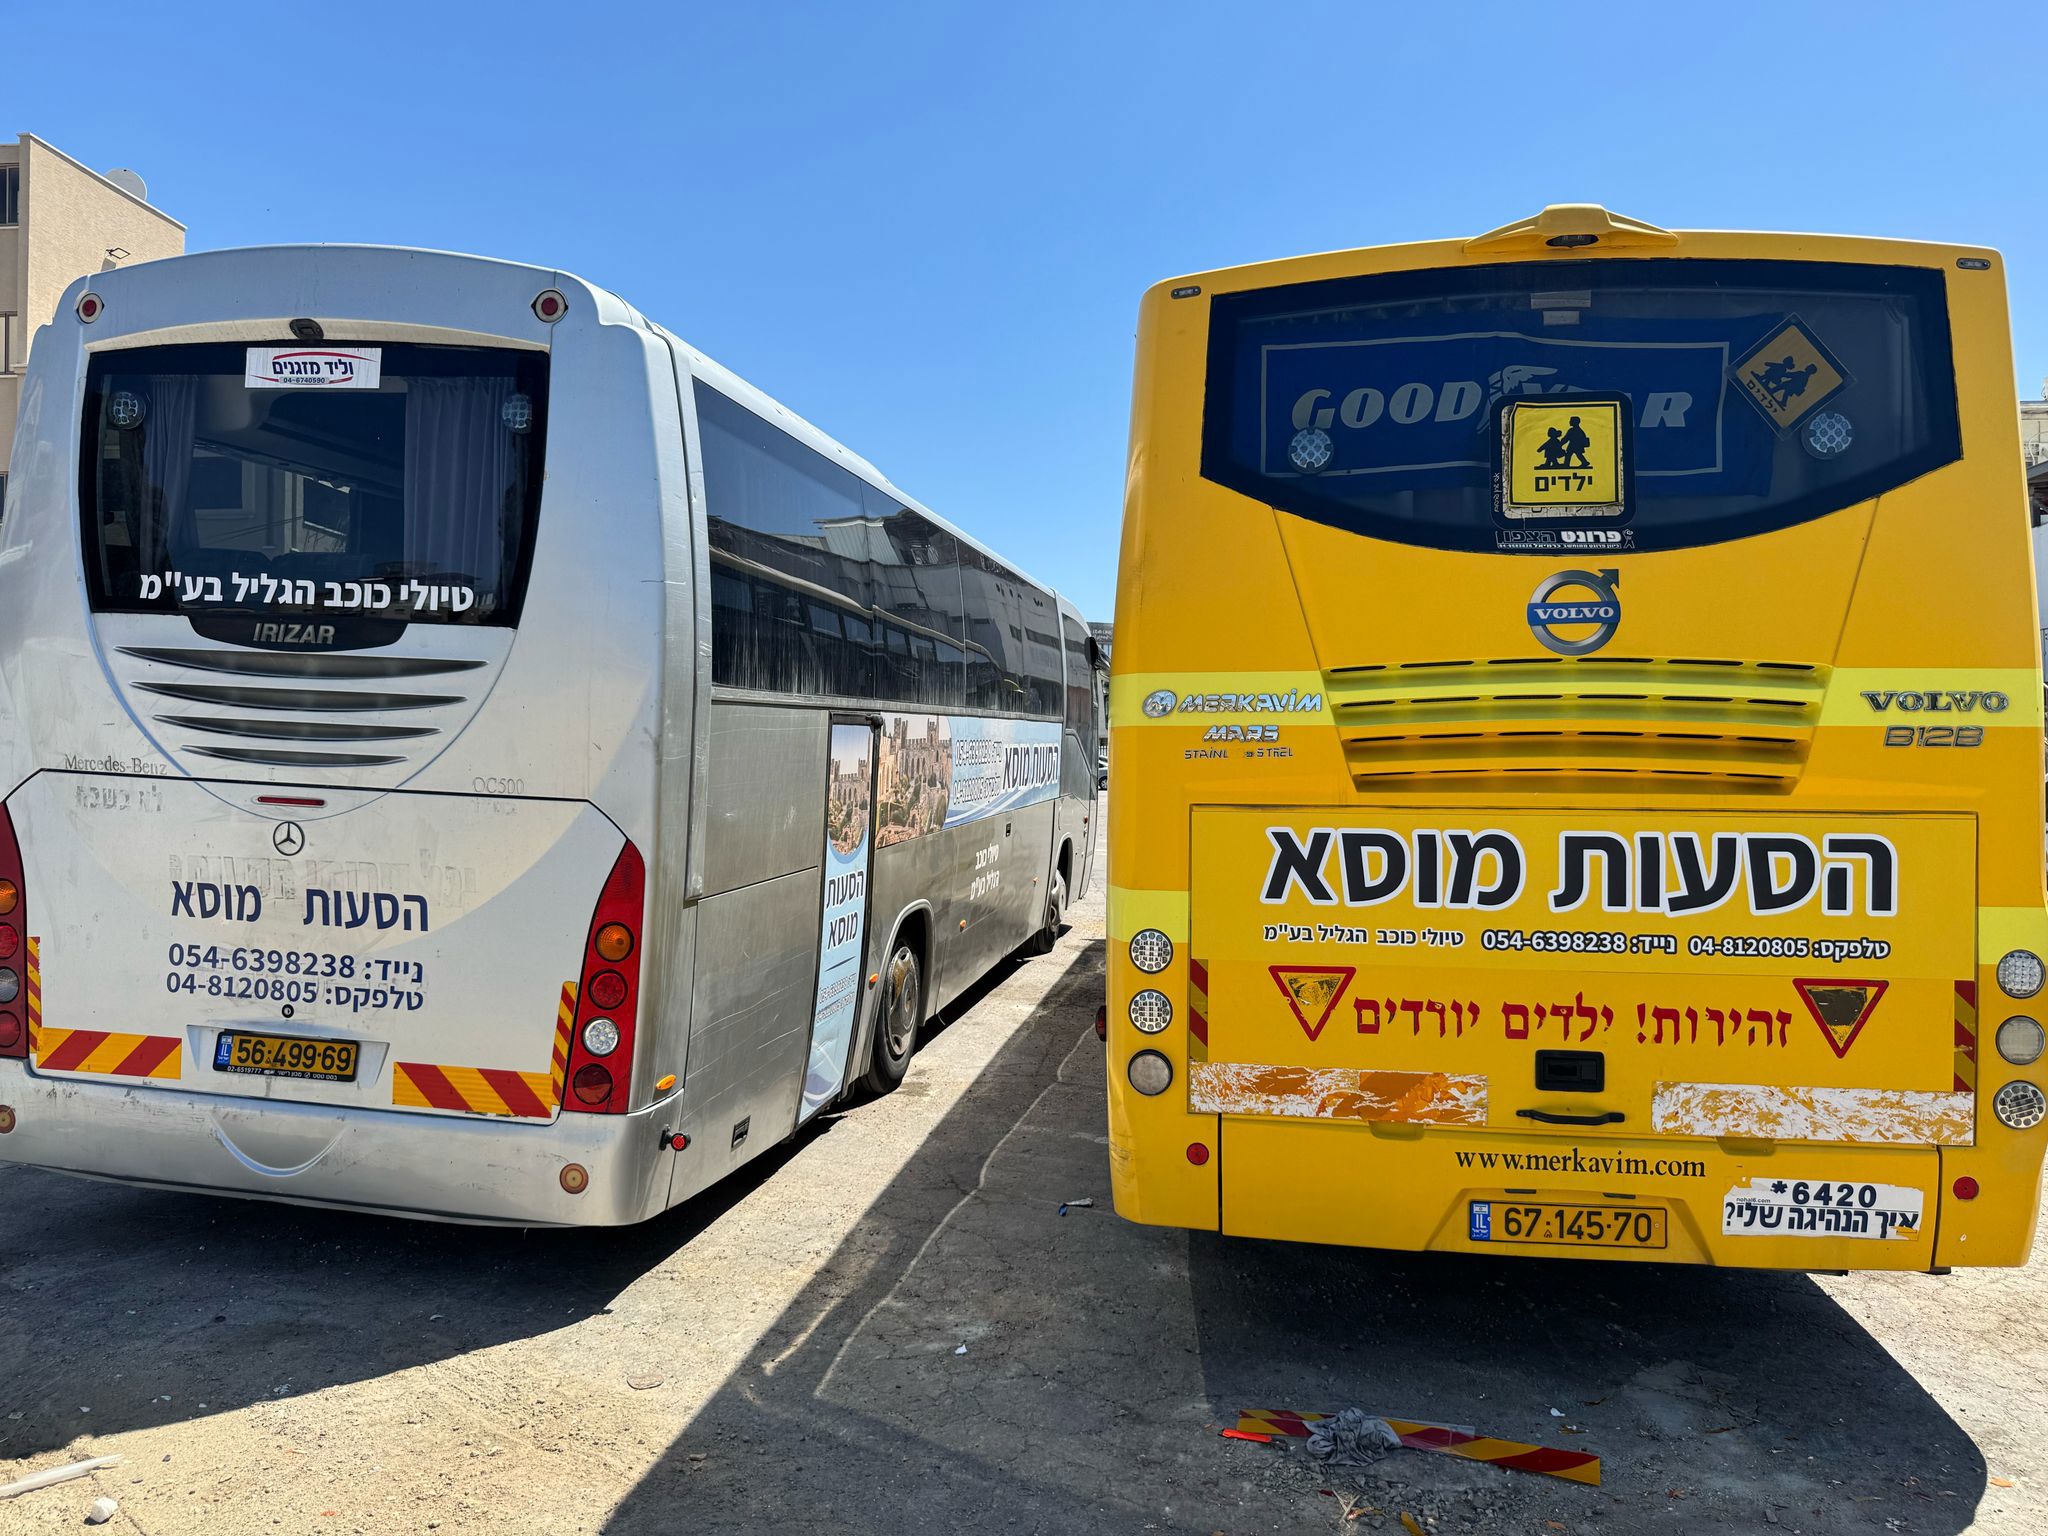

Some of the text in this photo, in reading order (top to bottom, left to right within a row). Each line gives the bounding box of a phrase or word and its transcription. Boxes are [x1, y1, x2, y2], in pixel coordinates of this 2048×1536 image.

[272, 359, 354, 375] וליד מזגנים
[1534, 472, 1594, 492] ילדים
[1560, 530, 1622, 543] פרונט
[231, 572, 315, 605] הגליל
[323, 581, 392, 609] כוכב
[400, 579, 475, 612] טיולי
[1533, 606, 1614, 619] VOLVO
[253, 622, 336, 645] IRIZAR
[1860, 691, 2009, 713] VOLVO
[1202, 724, 1280, 743] MARS
[1883, 725, 1985, 748] B12B
[64, 754, 168, 775] Mercedes-Benz
[1002, 745, 1059, 790] הסעות מוסא
[472, 777, 525, 794] OC500
[1260, 826, 1900, 918] הסעות מוסא
[826, 870, 864, 909] הסעות
[171, 880, 429, 931] הסעות מוסא
[827, 911, 859, 950] מוסא
[1317, 924, 1369, 944] הגליל
[1376, 930, 1417, 946] כוכב
[1421, 928, 1465, 947] טיולי
[1481, 929, 1892, 963] טלפקס: 04-8120805 נייד: 054-6398238
[168, 943, 424, 983] נייד: 054-6398238
[166, 972, 424, 1012] טלפקס: 04-8120805
[1353, 991, 1793, 1048] זהירות! ילדים יורדים
[221, 1044, 229, 1056] IL
[1454, 1147, 1706, 1178] www.merkavim.com
[1476, 1214, 1487, 1228] IL
[1725, 1202, 1919, 1238] איך הנהיגה שלי?
